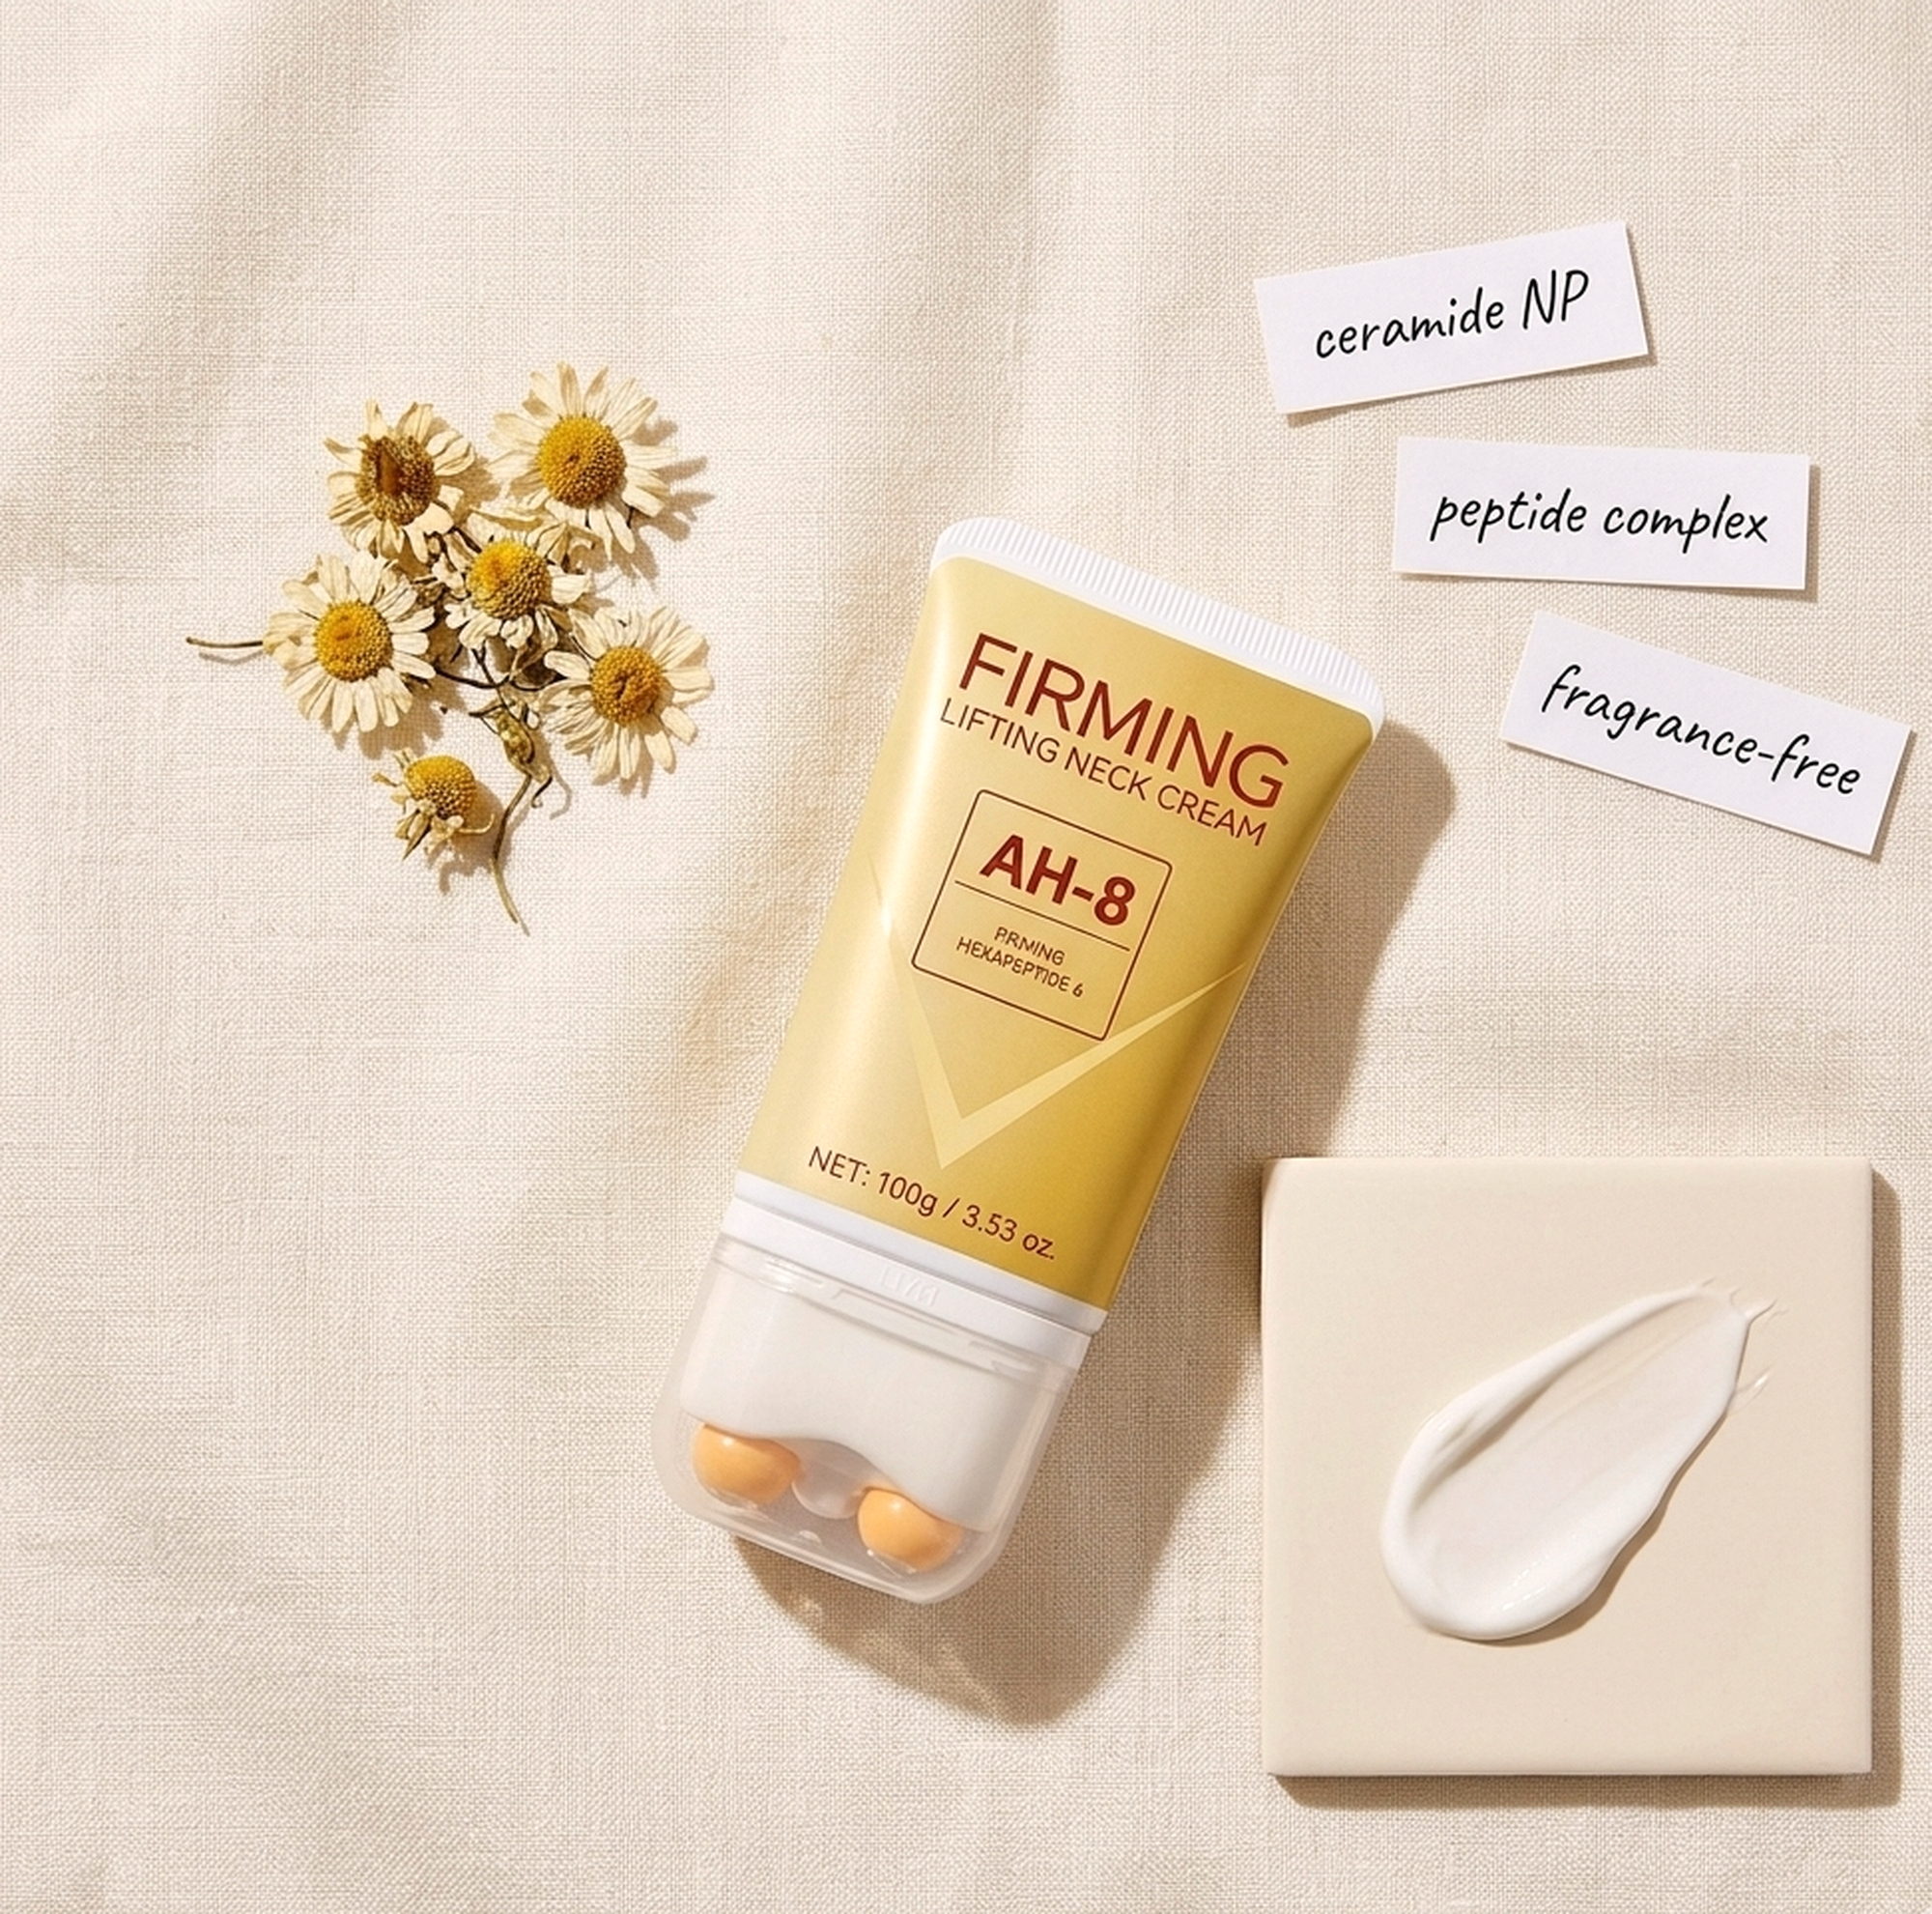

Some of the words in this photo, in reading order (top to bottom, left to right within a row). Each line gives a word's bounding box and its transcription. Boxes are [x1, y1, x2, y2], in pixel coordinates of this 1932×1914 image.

[1316, 286, 1505, 359] ceramide
[1521, 269, 1590, 330] NP
[1429, 487, 1588, 545] peptide
[1603, 493, 1769, 555] complex
[940, 697, 1061, 764] LIFTING
[1064, 746, 1153, 802] NECK
[1156, 784, 1267, 847] CREAM
[958, 632, 1290, 810] FIRMING
[1541, 664, 1861, 795] fragrance-free
[979, 834, 1136, 927] AH-8
[808, 1145, 871, 1186] NET:
[878, 1171, 939, 1217] 100g
[942, 1197, 961, 1218] /
[961, 1204, 1018, 1243] 3.53
[1021, 1233, 1056, 1261] oz.
